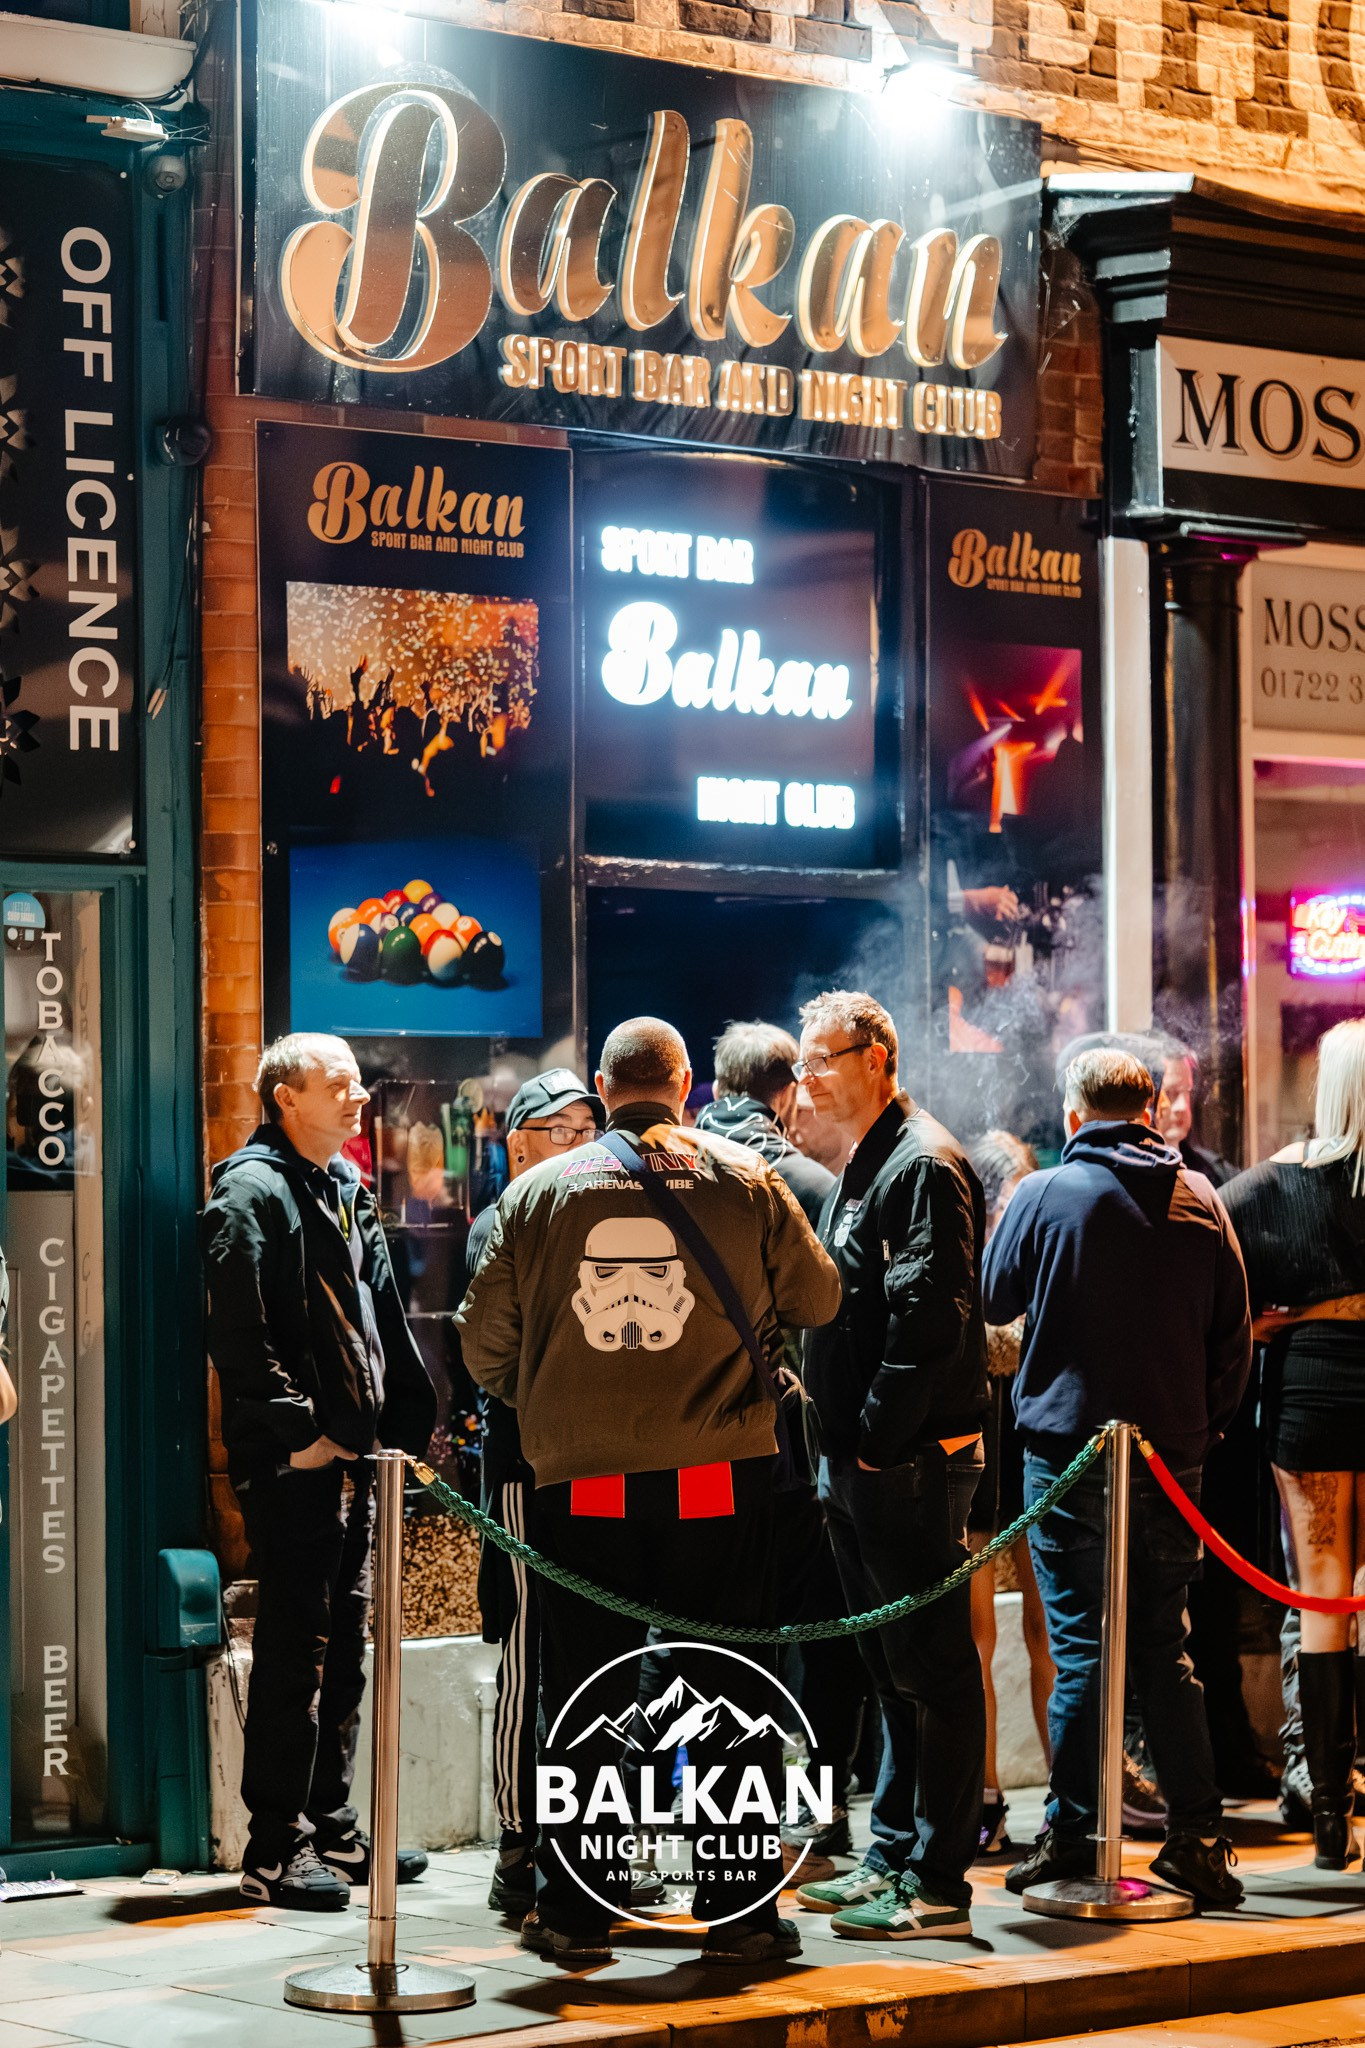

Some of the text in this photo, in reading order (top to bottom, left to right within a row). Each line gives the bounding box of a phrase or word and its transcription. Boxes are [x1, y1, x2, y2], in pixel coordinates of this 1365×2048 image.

[282, 80, 1008, 373] Balkan
[502, 333, 1002, 440] SPORT BAR AND NIGHT CLUB
[60, 226, 119, 752] OFF LICENCE
[307, 461, 525, 544] Balkan
[371, 530, 524, 559] SPORT BAR AND NIGHT CLUB
[600, 525, 755, 585] SPORT BAR
[948, 528, 1082, 588] Balkan
[601, 601, 853, 720] Balkan
[1261, 666, 1340, 702] 01722
[36, 931, 66, 1167] TOBACCO
[581, 1179, 644, 1191] ARENAS
[43, 1644, 70, 1777] BEER
